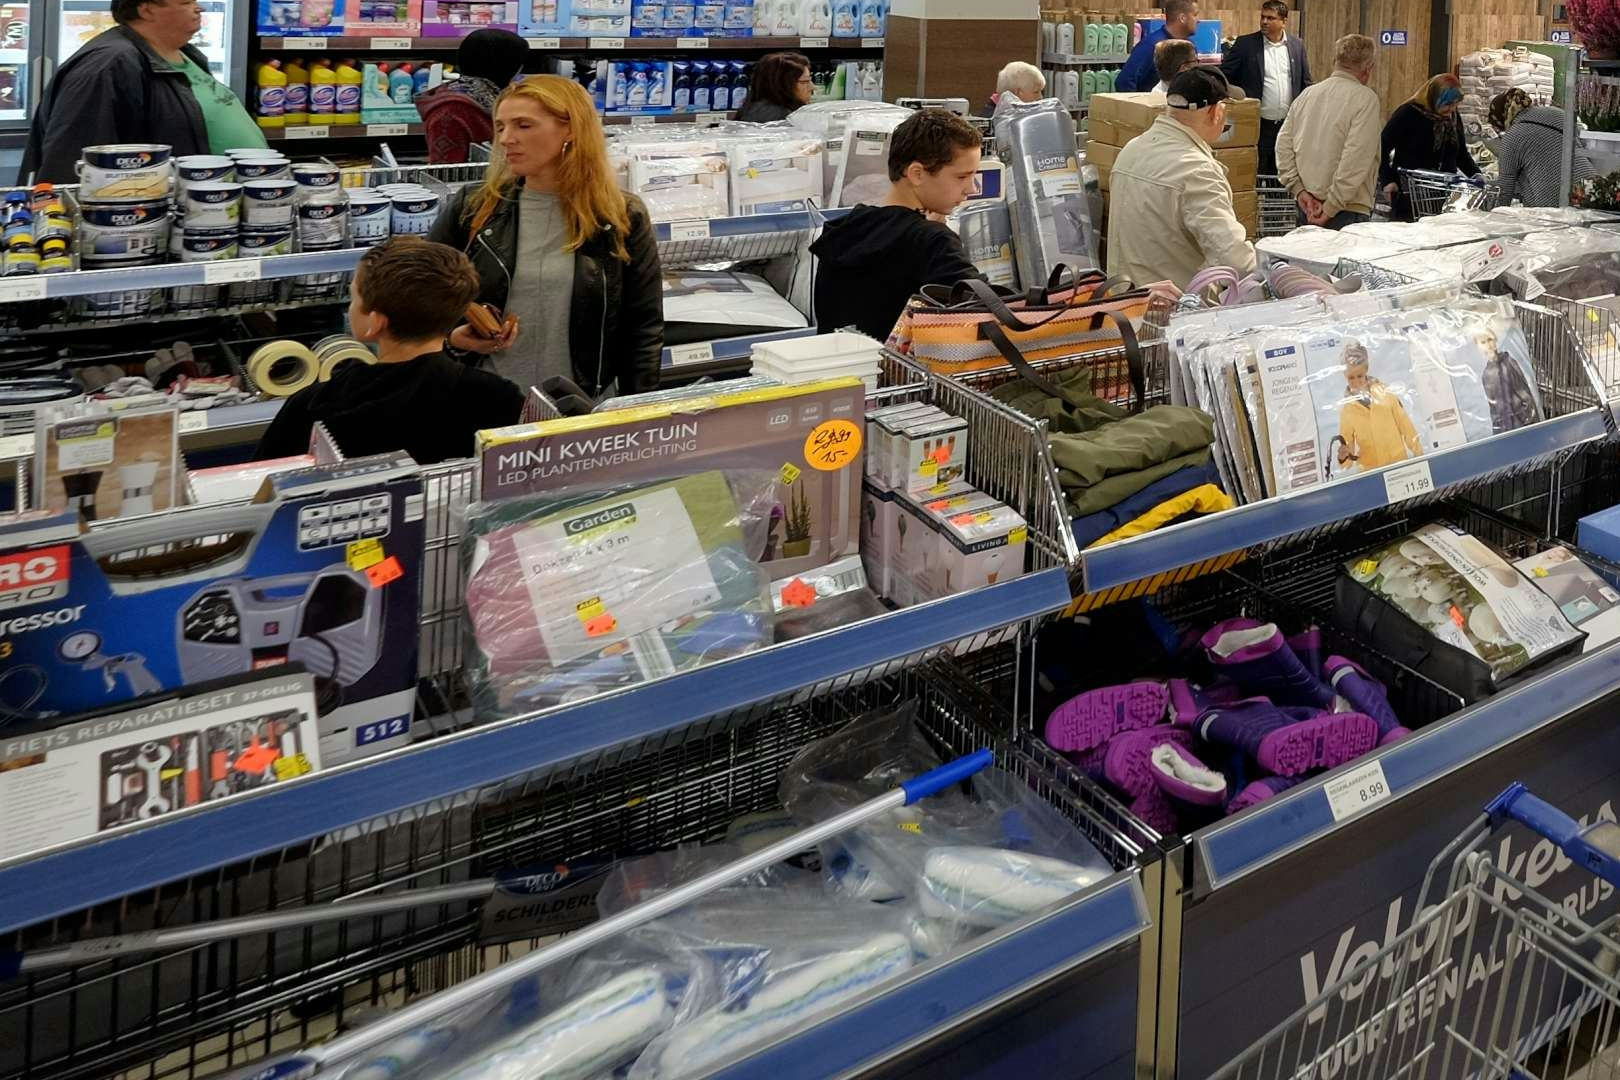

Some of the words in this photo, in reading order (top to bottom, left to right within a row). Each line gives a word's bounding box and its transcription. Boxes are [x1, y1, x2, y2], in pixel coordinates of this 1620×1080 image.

[770, 414, 789, 425] LED
[499, 446, 550, 470] MINI
[560, 431, 640, 460] KWEEK
[644, 422, 698, 444] TUIN
[498, 471, 527, 486] LED
[532, 439, 698, 480] PLANTENVERLICHTING
[1406, 478, 1429, 493] 11.99
[568, 505, 632, 532] Garden
[5, 734, 69, 758] FIETS
[77, 692, 236, 744] REPARATIESET
[362, 719, 403, 742] 512
[1359, 782, 1385, 802] 8.99
